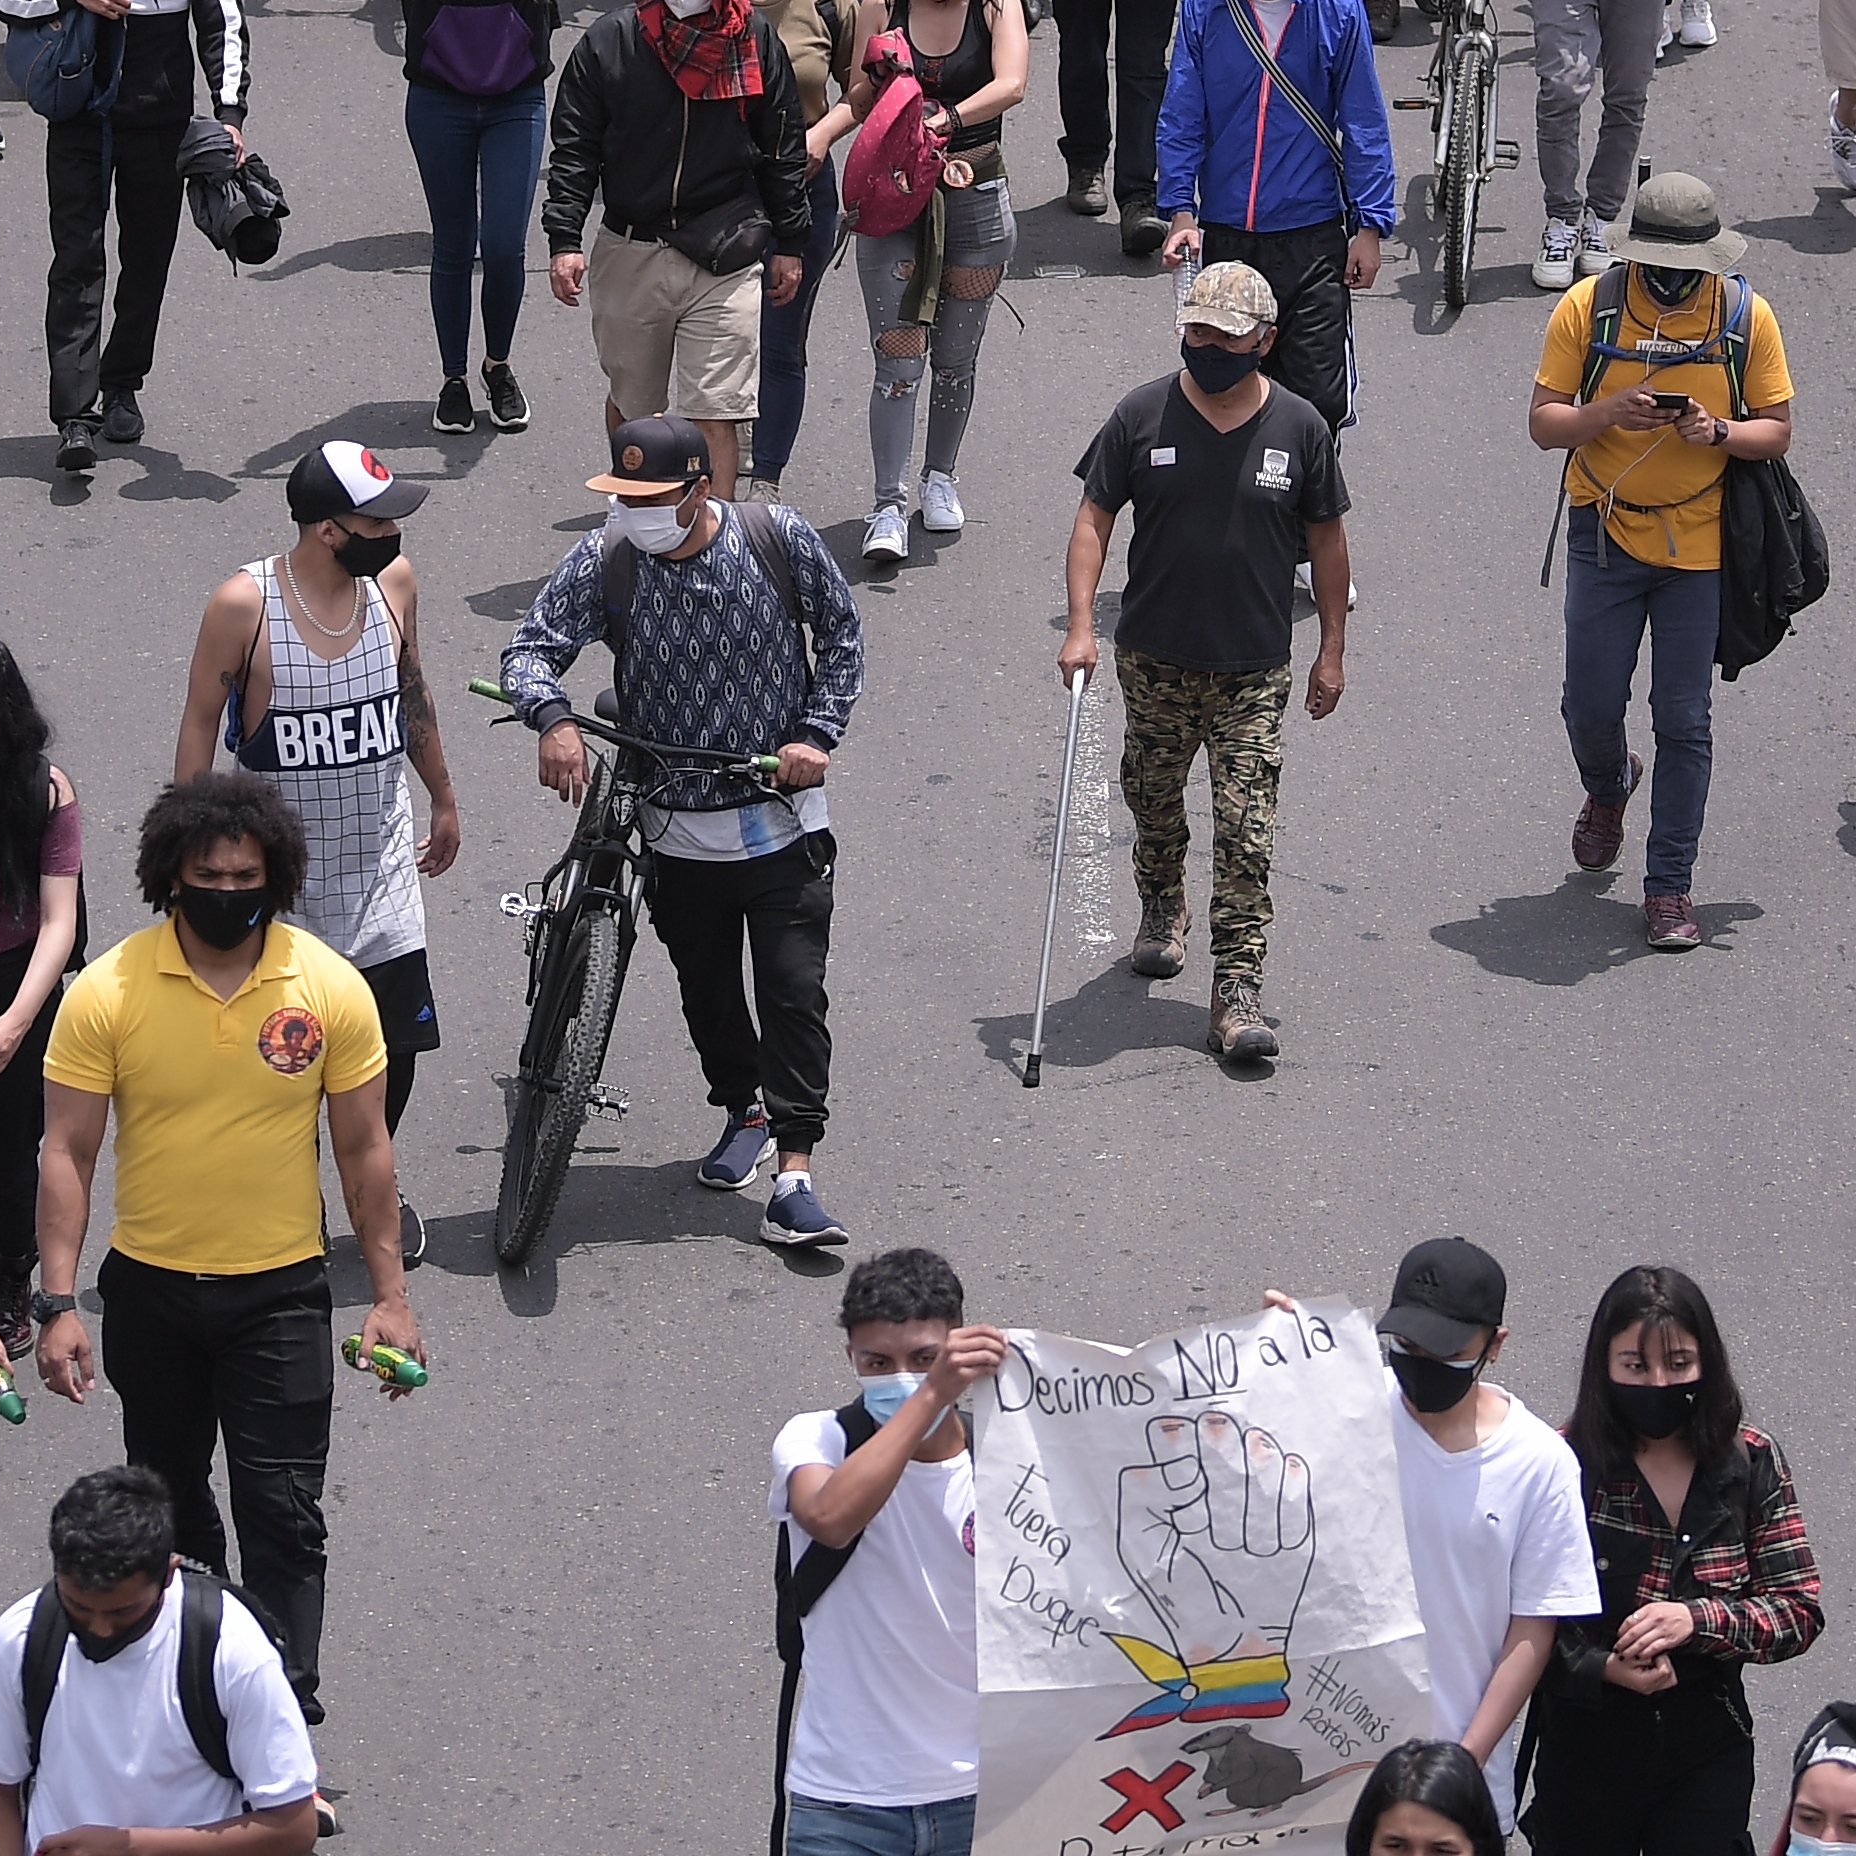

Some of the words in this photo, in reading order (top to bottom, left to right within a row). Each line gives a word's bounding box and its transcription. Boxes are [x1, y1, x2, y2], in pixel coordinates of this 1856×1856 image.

[1255, 471, 1292, 485] WAIVER
[273, 693, 404, 767] BREAK
[995, 1341, 1155, 1421] Decimos
[1173, 1331, 1240, 1401] NO
[1258, 1336, 1289, 1366] a
[1294, 1308, 1338, 1360] la
[1004, 1463, 1072, 1567] Fuera
[999, 1555, 1102, 1648] Duque
[1300, 1705, 1362, 1759] Ratas
